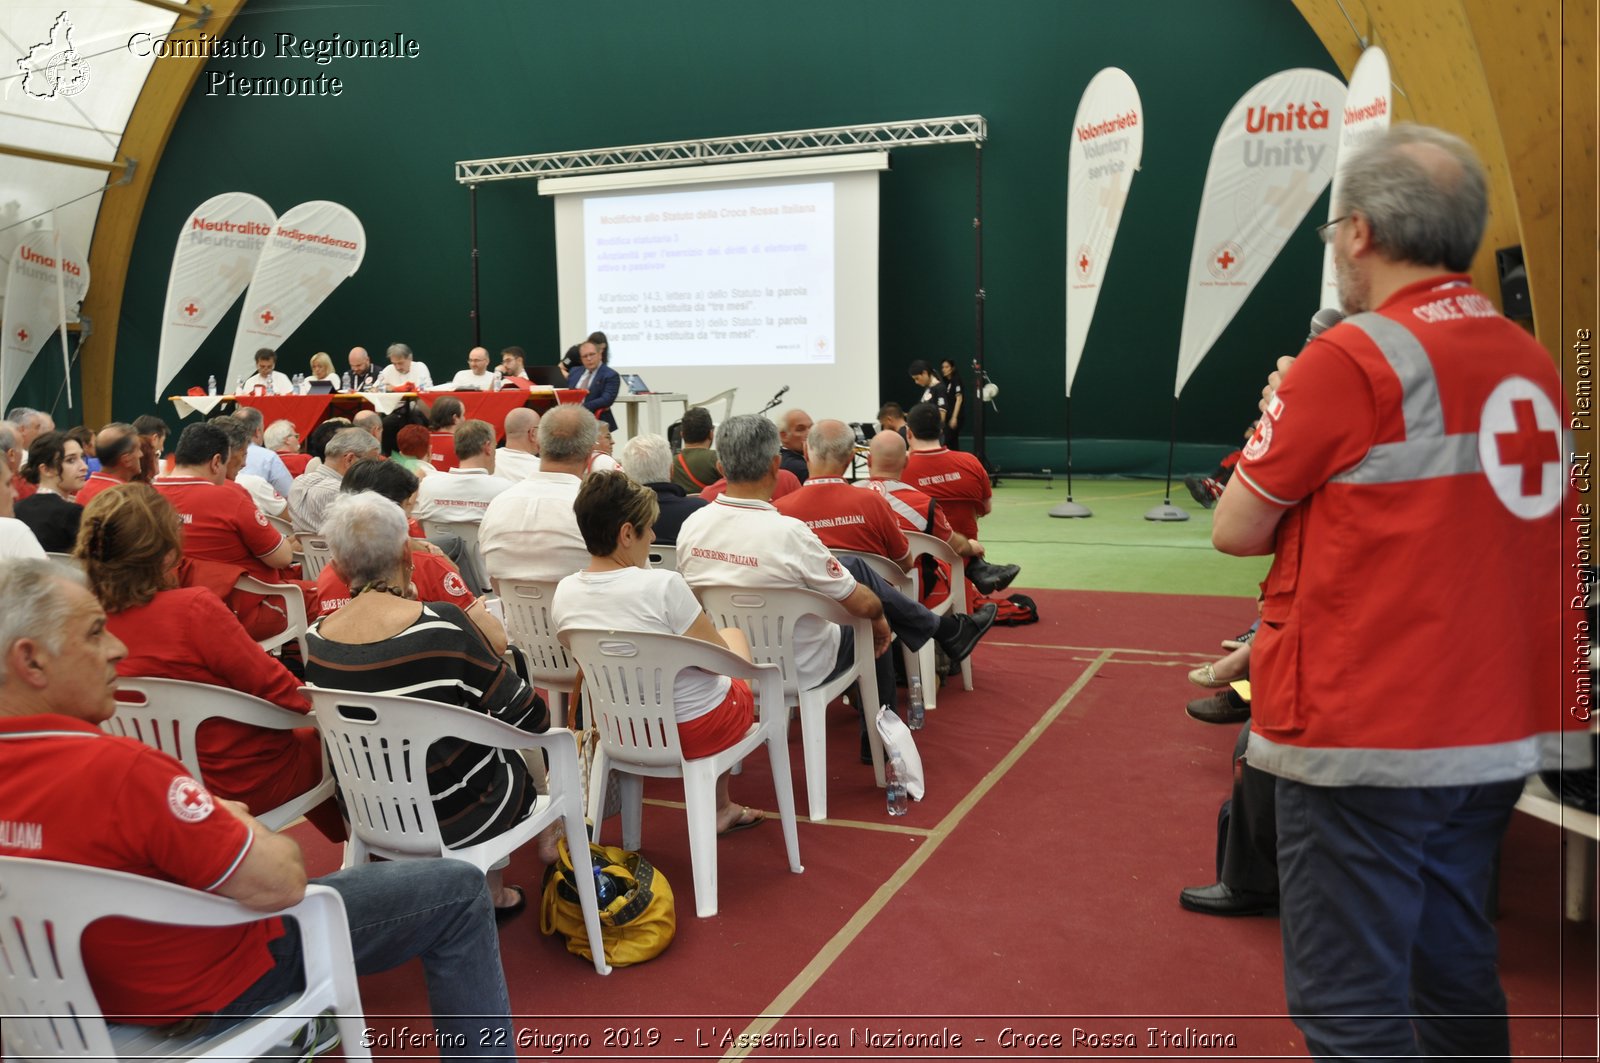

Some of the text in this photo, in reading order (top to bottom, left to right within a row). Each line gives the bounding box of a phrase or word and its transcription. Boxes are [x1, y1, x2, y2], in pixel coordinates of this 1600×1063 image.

[1077, 110, 1137, 141] Volontarietà
[1246, 101, 1329, 133] Unità
[1083, 136, 1130, 159] Voluntary
[1242, 138, 1326, 173] Unity
[1088, 159, 1125, 180] service
[600, 204, 816, 225] Modifiche allo Statuto della Croce Rossa Italiana
[193, 217, 270, 236] Neutralità
[277, 226, 357, 250] Indipendenza
[20, 245, 81, 276] Umaità
[642, 251, 657, 262] per
[751, 244, 761, 254] di
[15, 259, 84, 296] Humaity
[665, 291, 692, 301] lettera
[695, 290, 704, 301] a)
[707, 289, 728, 299] dello
[731, 288, 762, 298] Statuto
[765, 287, 774, 297] la
[777, 286, 808, 299] parola
[651, 303, 692, 313] sostituita
[694, 302, 705, 312] da
[1412, 297, 1463, 323] CROCE
[666, 319, 692, 328] lettera
[695, 318, 705, 329] b)
[707, 317, 729, 327] dello
[731, 317, 762, 327] Statuto
[765, 316, 774, 326] la
[777, 315, 808, 327] parola
[654, 331, 695, 341] sostituita
[697, 331, 708, 340] da
[815, 518, 835, 528] ROSSA
[835, 515, 865, 526] ITALIANA
[691, 548, 759, 567] CROCE ROSSA ITALIANA
[0, 820, 42, 849] ALIANA
